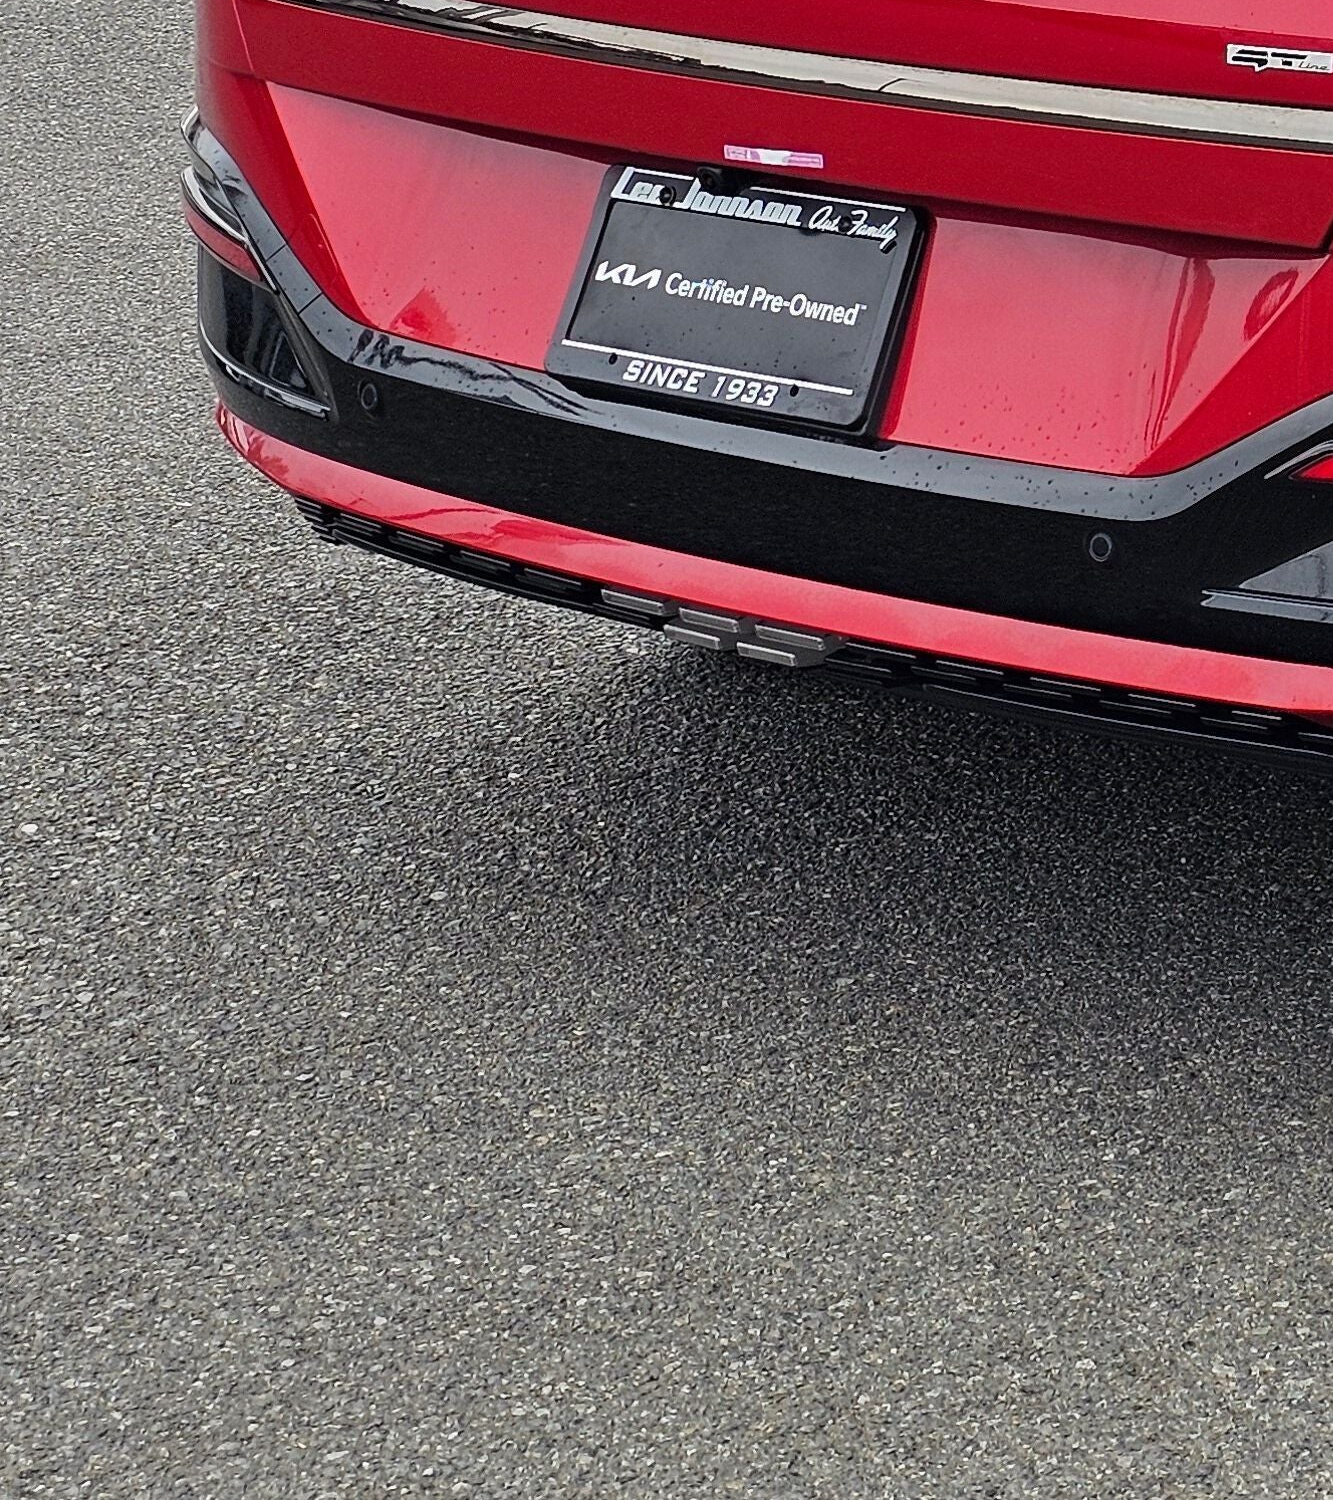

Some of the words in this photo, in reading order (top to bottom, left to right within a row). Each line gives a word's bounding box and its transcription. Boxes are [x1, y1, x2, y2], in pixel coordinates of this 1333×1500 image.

[808, 205, 842, 231] Aut
[594, 260, 662, 290] KIA
[665, 273, 749, 307] Certified
[622, 360, 706, 395] SINCE
[711, 375, 779, 408] 1933
